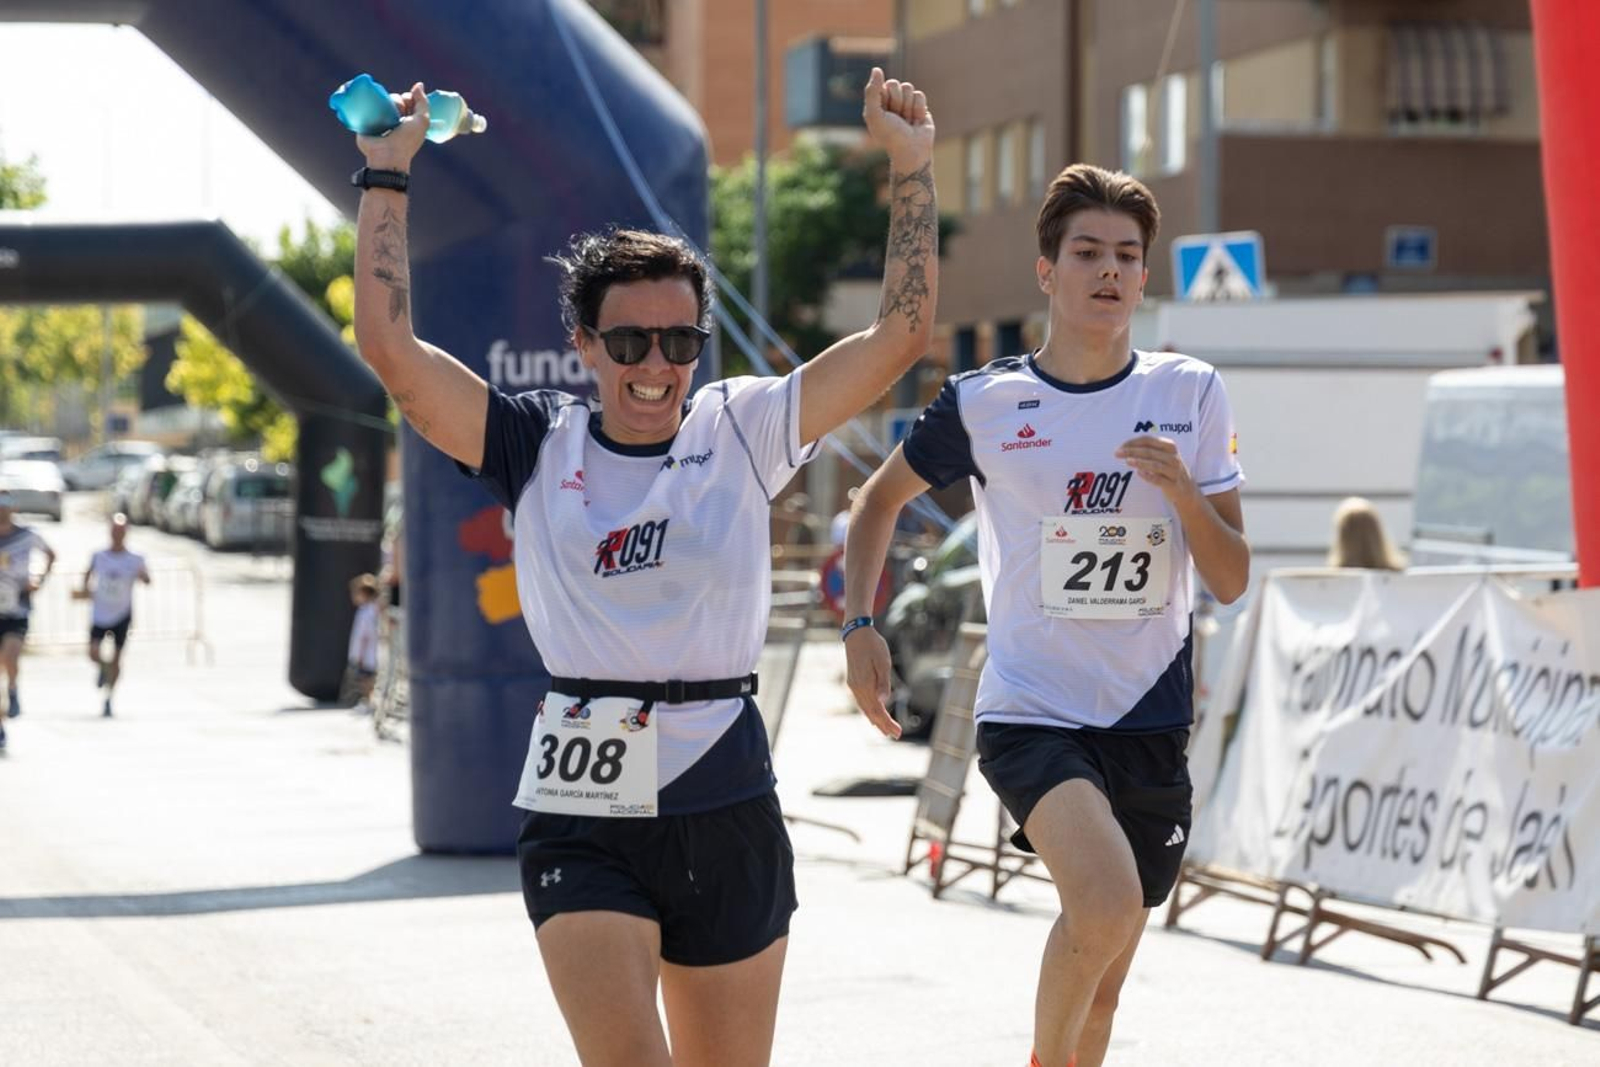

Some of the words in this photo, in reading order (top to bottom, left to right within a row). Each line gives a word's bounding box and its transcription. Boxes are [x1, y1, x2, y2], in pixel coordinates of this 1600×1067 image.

[485, 339, 598, 388] fund
[1160, 421, 1192, 434] mupol
[1001, 438, 1052, 451] Santander
[680, 448, 714, 468] mupol
[602, 561, 664, 578] SOLIDARIA
[1063, 551, 1151, 592] 213
[1068, 597, 1089, 605] DANIEL
[1089, 597, 1127, 605] VALDERRAMA
[537, 734, 627, 785] 308
[560, 787, 584, 799] GARCÍA
[585, 789, 620, 801] MARTÍNEZ
